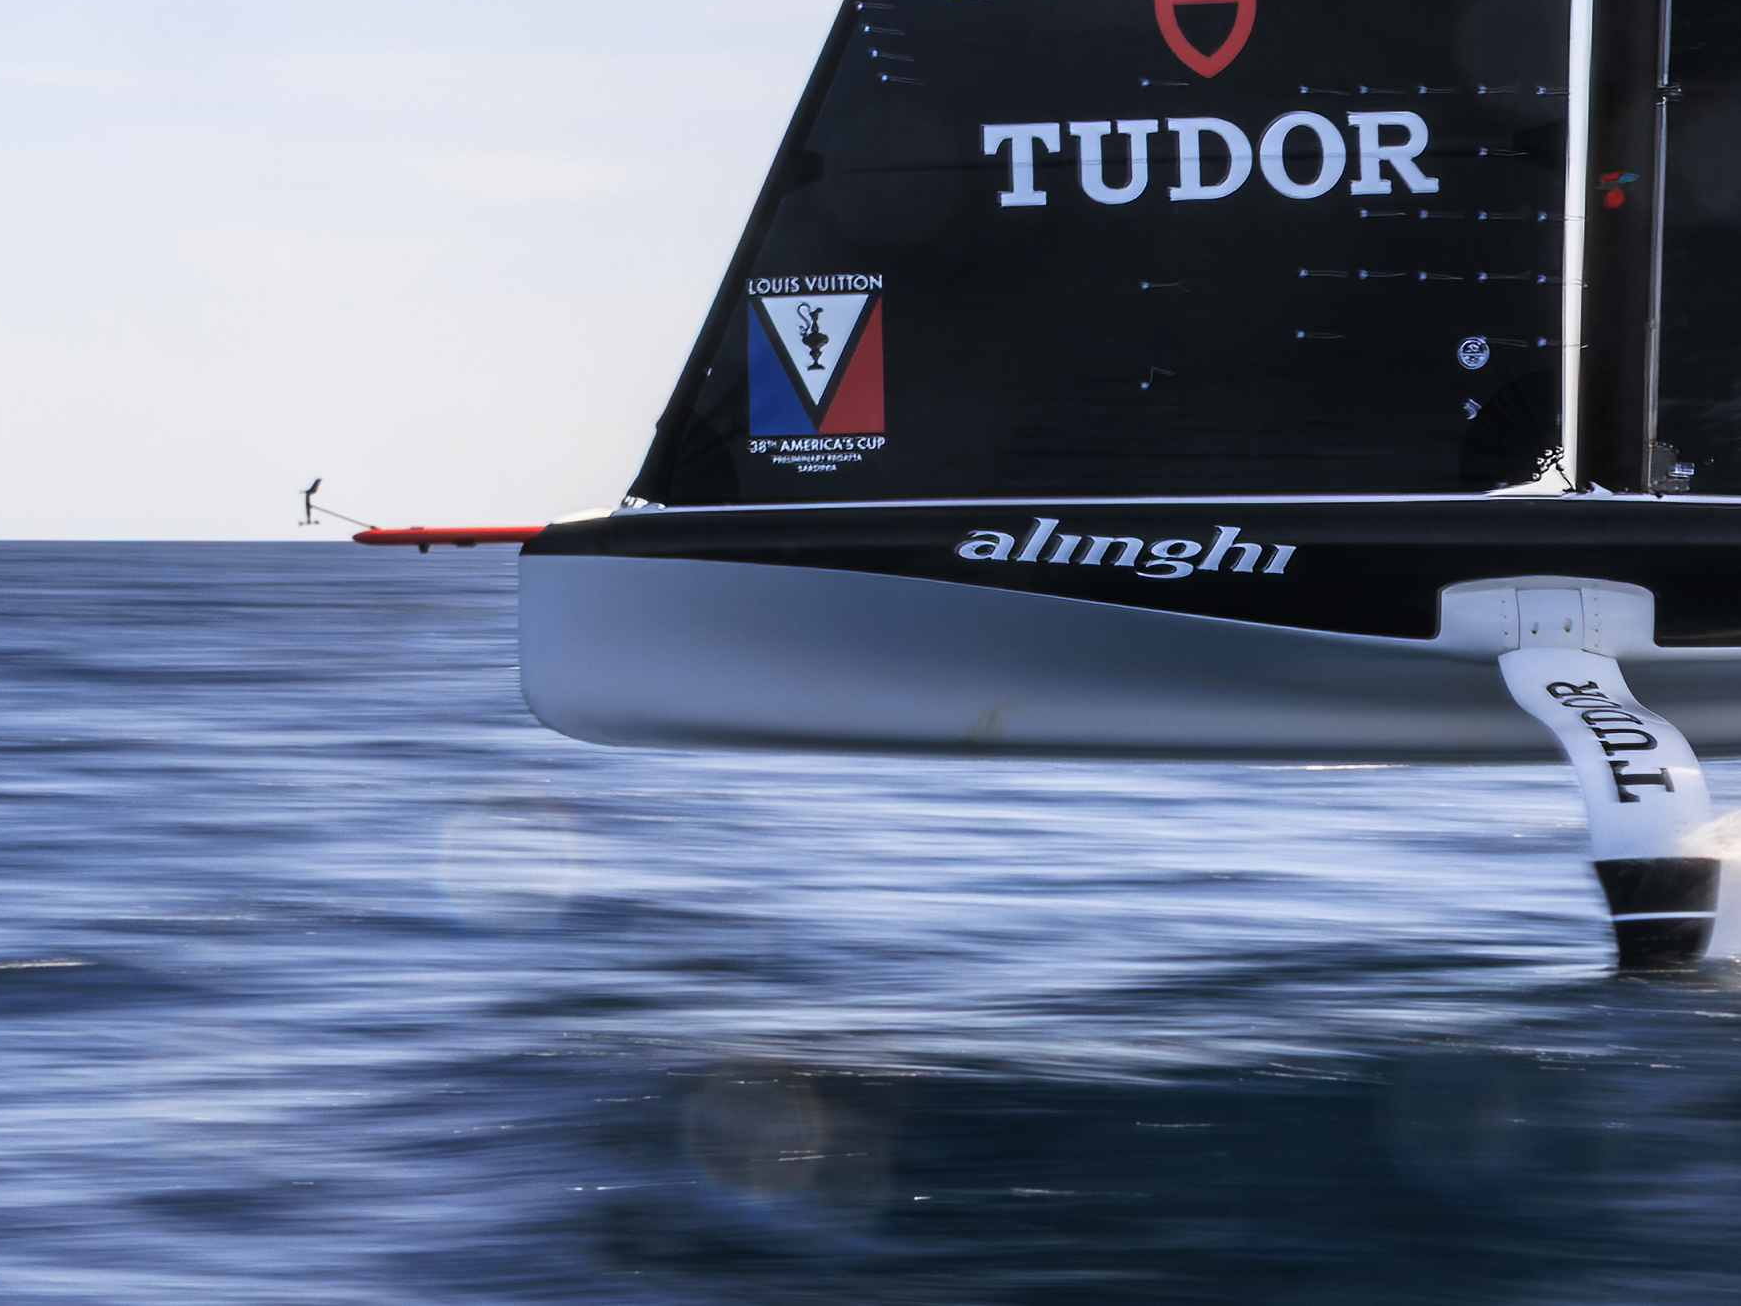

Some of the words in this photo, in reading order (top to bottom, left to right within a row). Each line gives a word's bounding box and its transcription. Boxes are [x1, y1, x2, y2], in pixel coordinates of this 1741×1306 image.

[981, 111, 1440, 206] TUDOR
[748, 277, 799, 294] LOUIS
[805, 274, 883, 291] VUITTON
[780, 438, 854, 451] AMERICA'S
[857, 437, 885, 449] CUP
[955, 517, 1298, 580] alinghi
[1546, 680, 1675, 804] TUDOR
